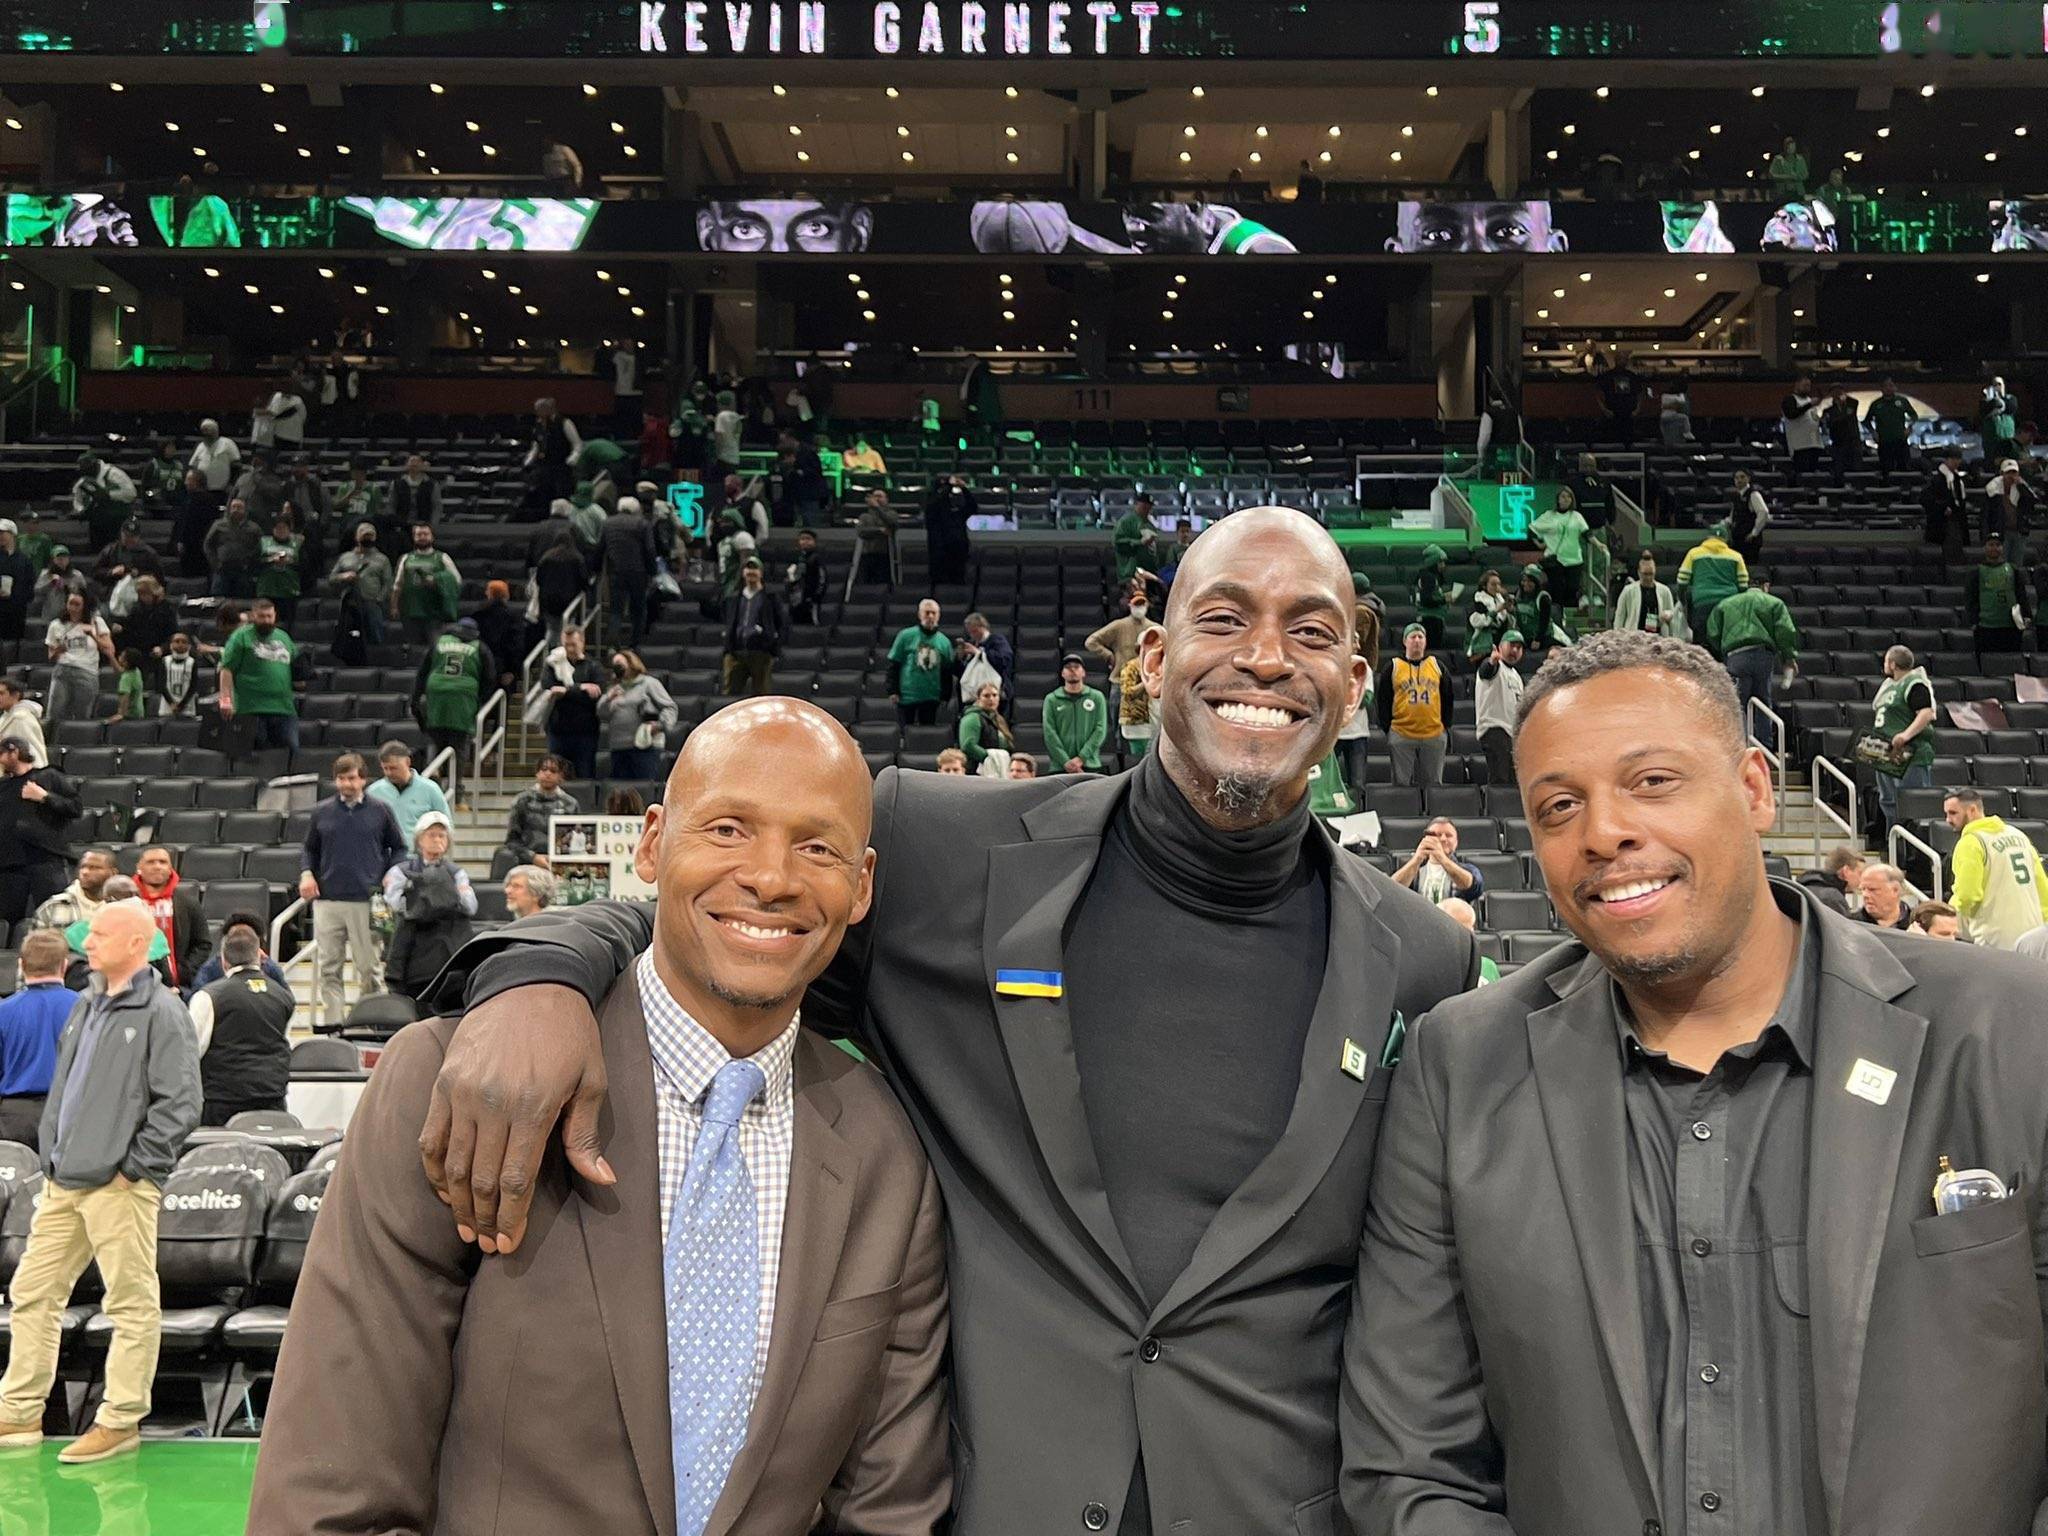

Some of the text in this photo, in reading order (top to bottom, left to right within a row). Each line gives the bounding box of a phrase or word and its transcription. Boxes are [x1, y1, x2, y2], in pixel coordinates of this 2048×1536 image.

[640, 1, 1160, 54] KEVIN GARNETT
[1464, 2, 1500, 52] 5
[1074, 388, 1112, 410] 111
[1502, 472, 1523, 486] EXIT
[445, 654, 463, 677] 5
[1408, 689, 1430, 704] 34
[2010, 853, 2031, 885] 5
[1351, 1050, 1361, 1070] 5
[163, 1188, 242, 1212] @celtics
